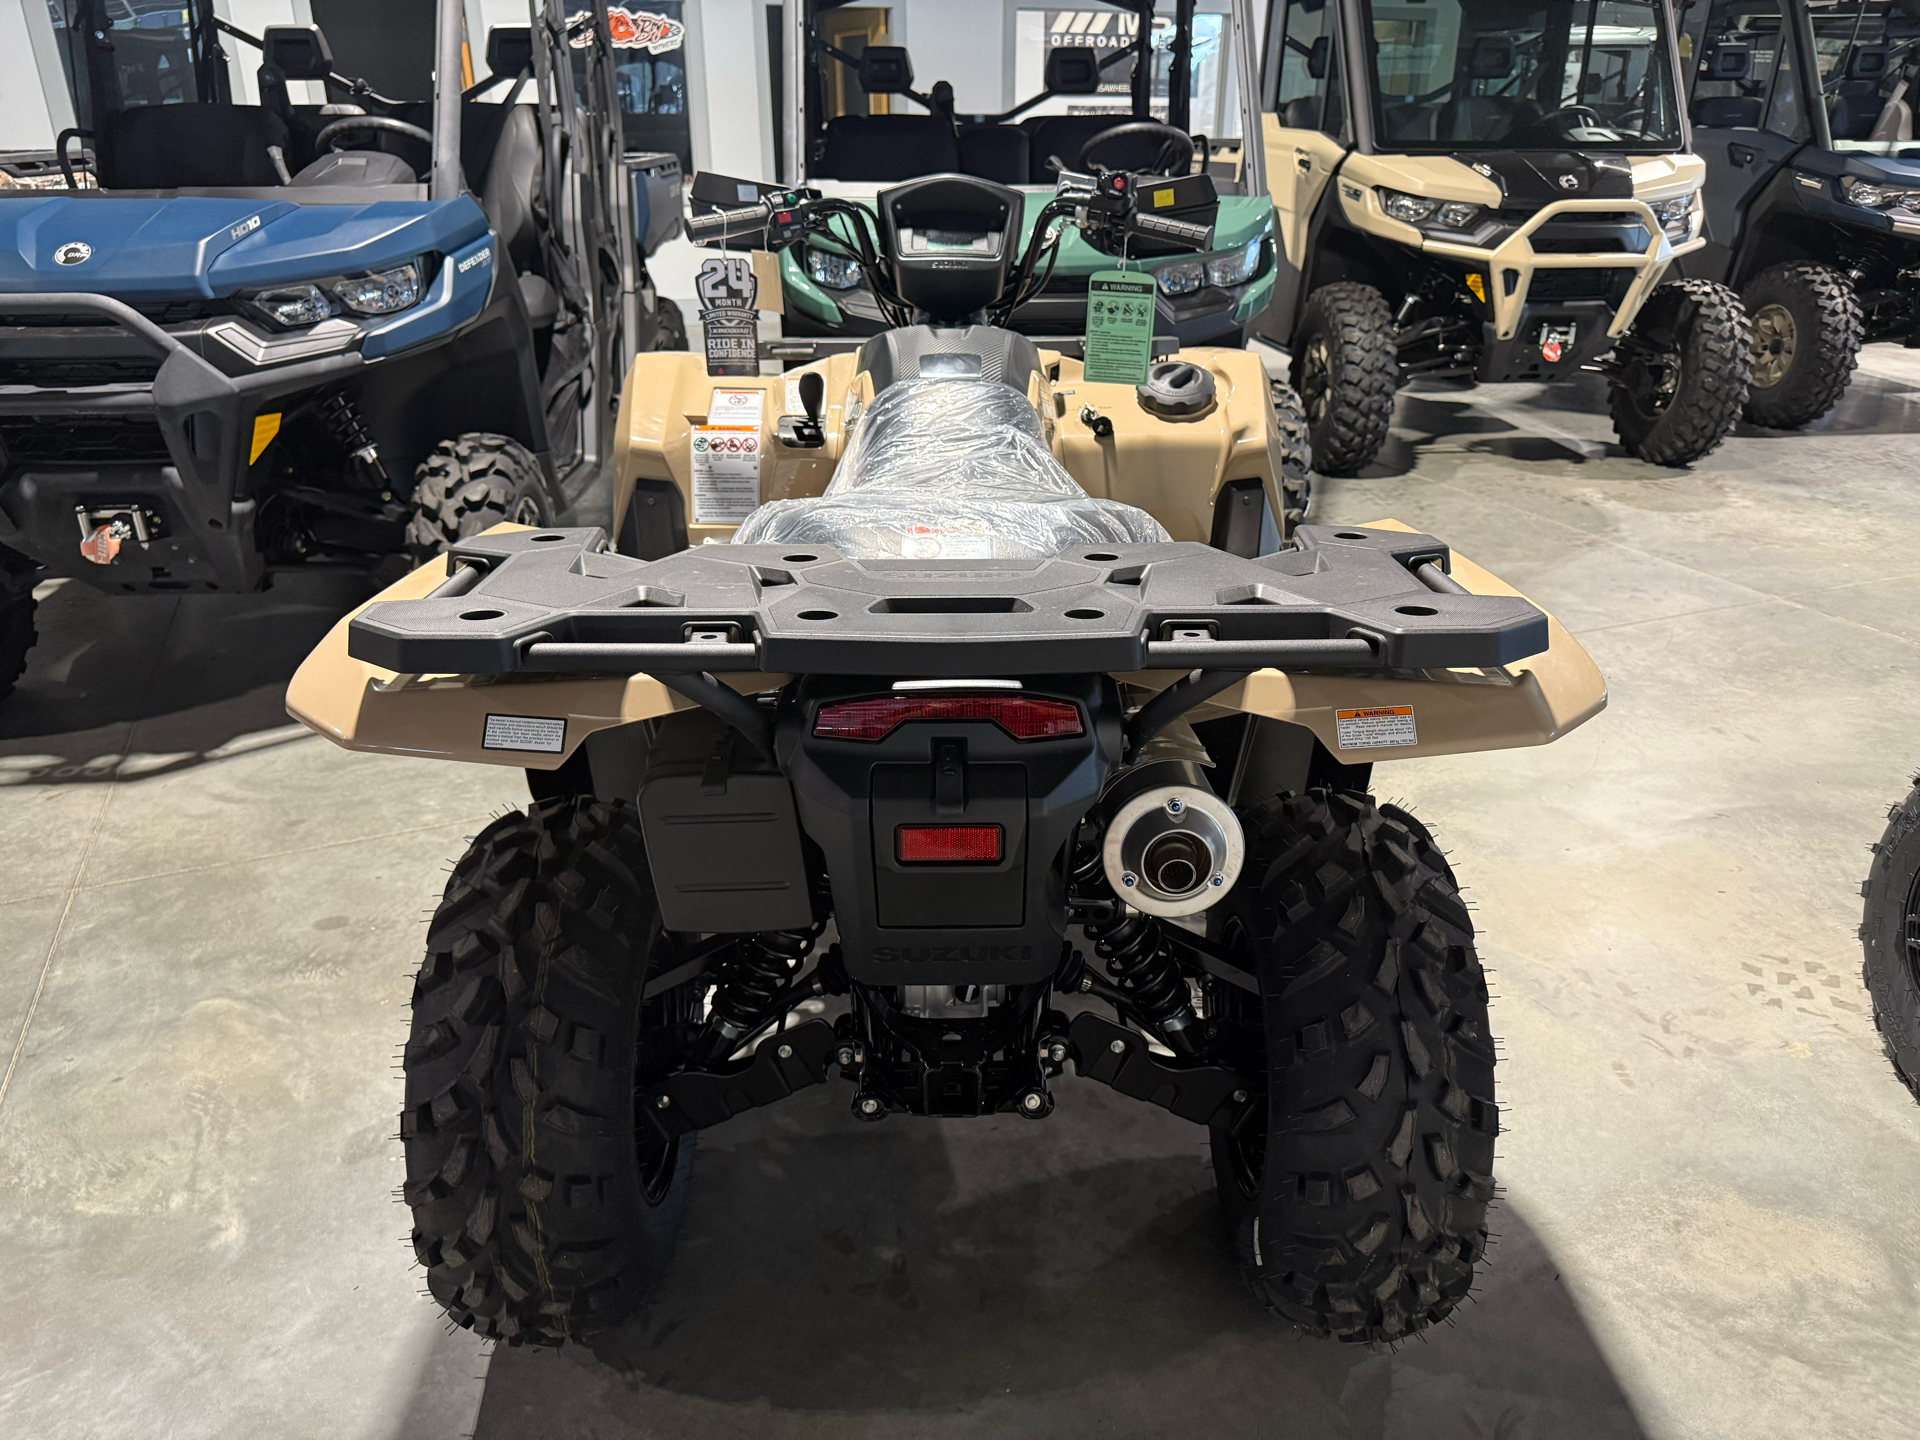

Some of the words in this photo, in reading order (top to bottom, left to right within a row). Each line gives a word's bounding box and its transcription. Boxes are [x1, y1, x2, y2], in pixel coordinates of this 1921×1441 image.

[230, 215, 261, 241] HD10
[458, 247, 492, 273] DEFENDER
[701, 258, 753, 298] 24
[1109, 283, 1143, 293] WARNING
[715, 298, 742, 307] MONTH
[705, 310, 726, 320] LIMITED
[726, 310, 754, 320] WARRANTY
[707, 338, 738, 349] RIDE
[740, 338, 756, 349] IN
[708, 349, 756, 358] CONFIDENCE
[872, 946, 1032, 964] SUZUKI
